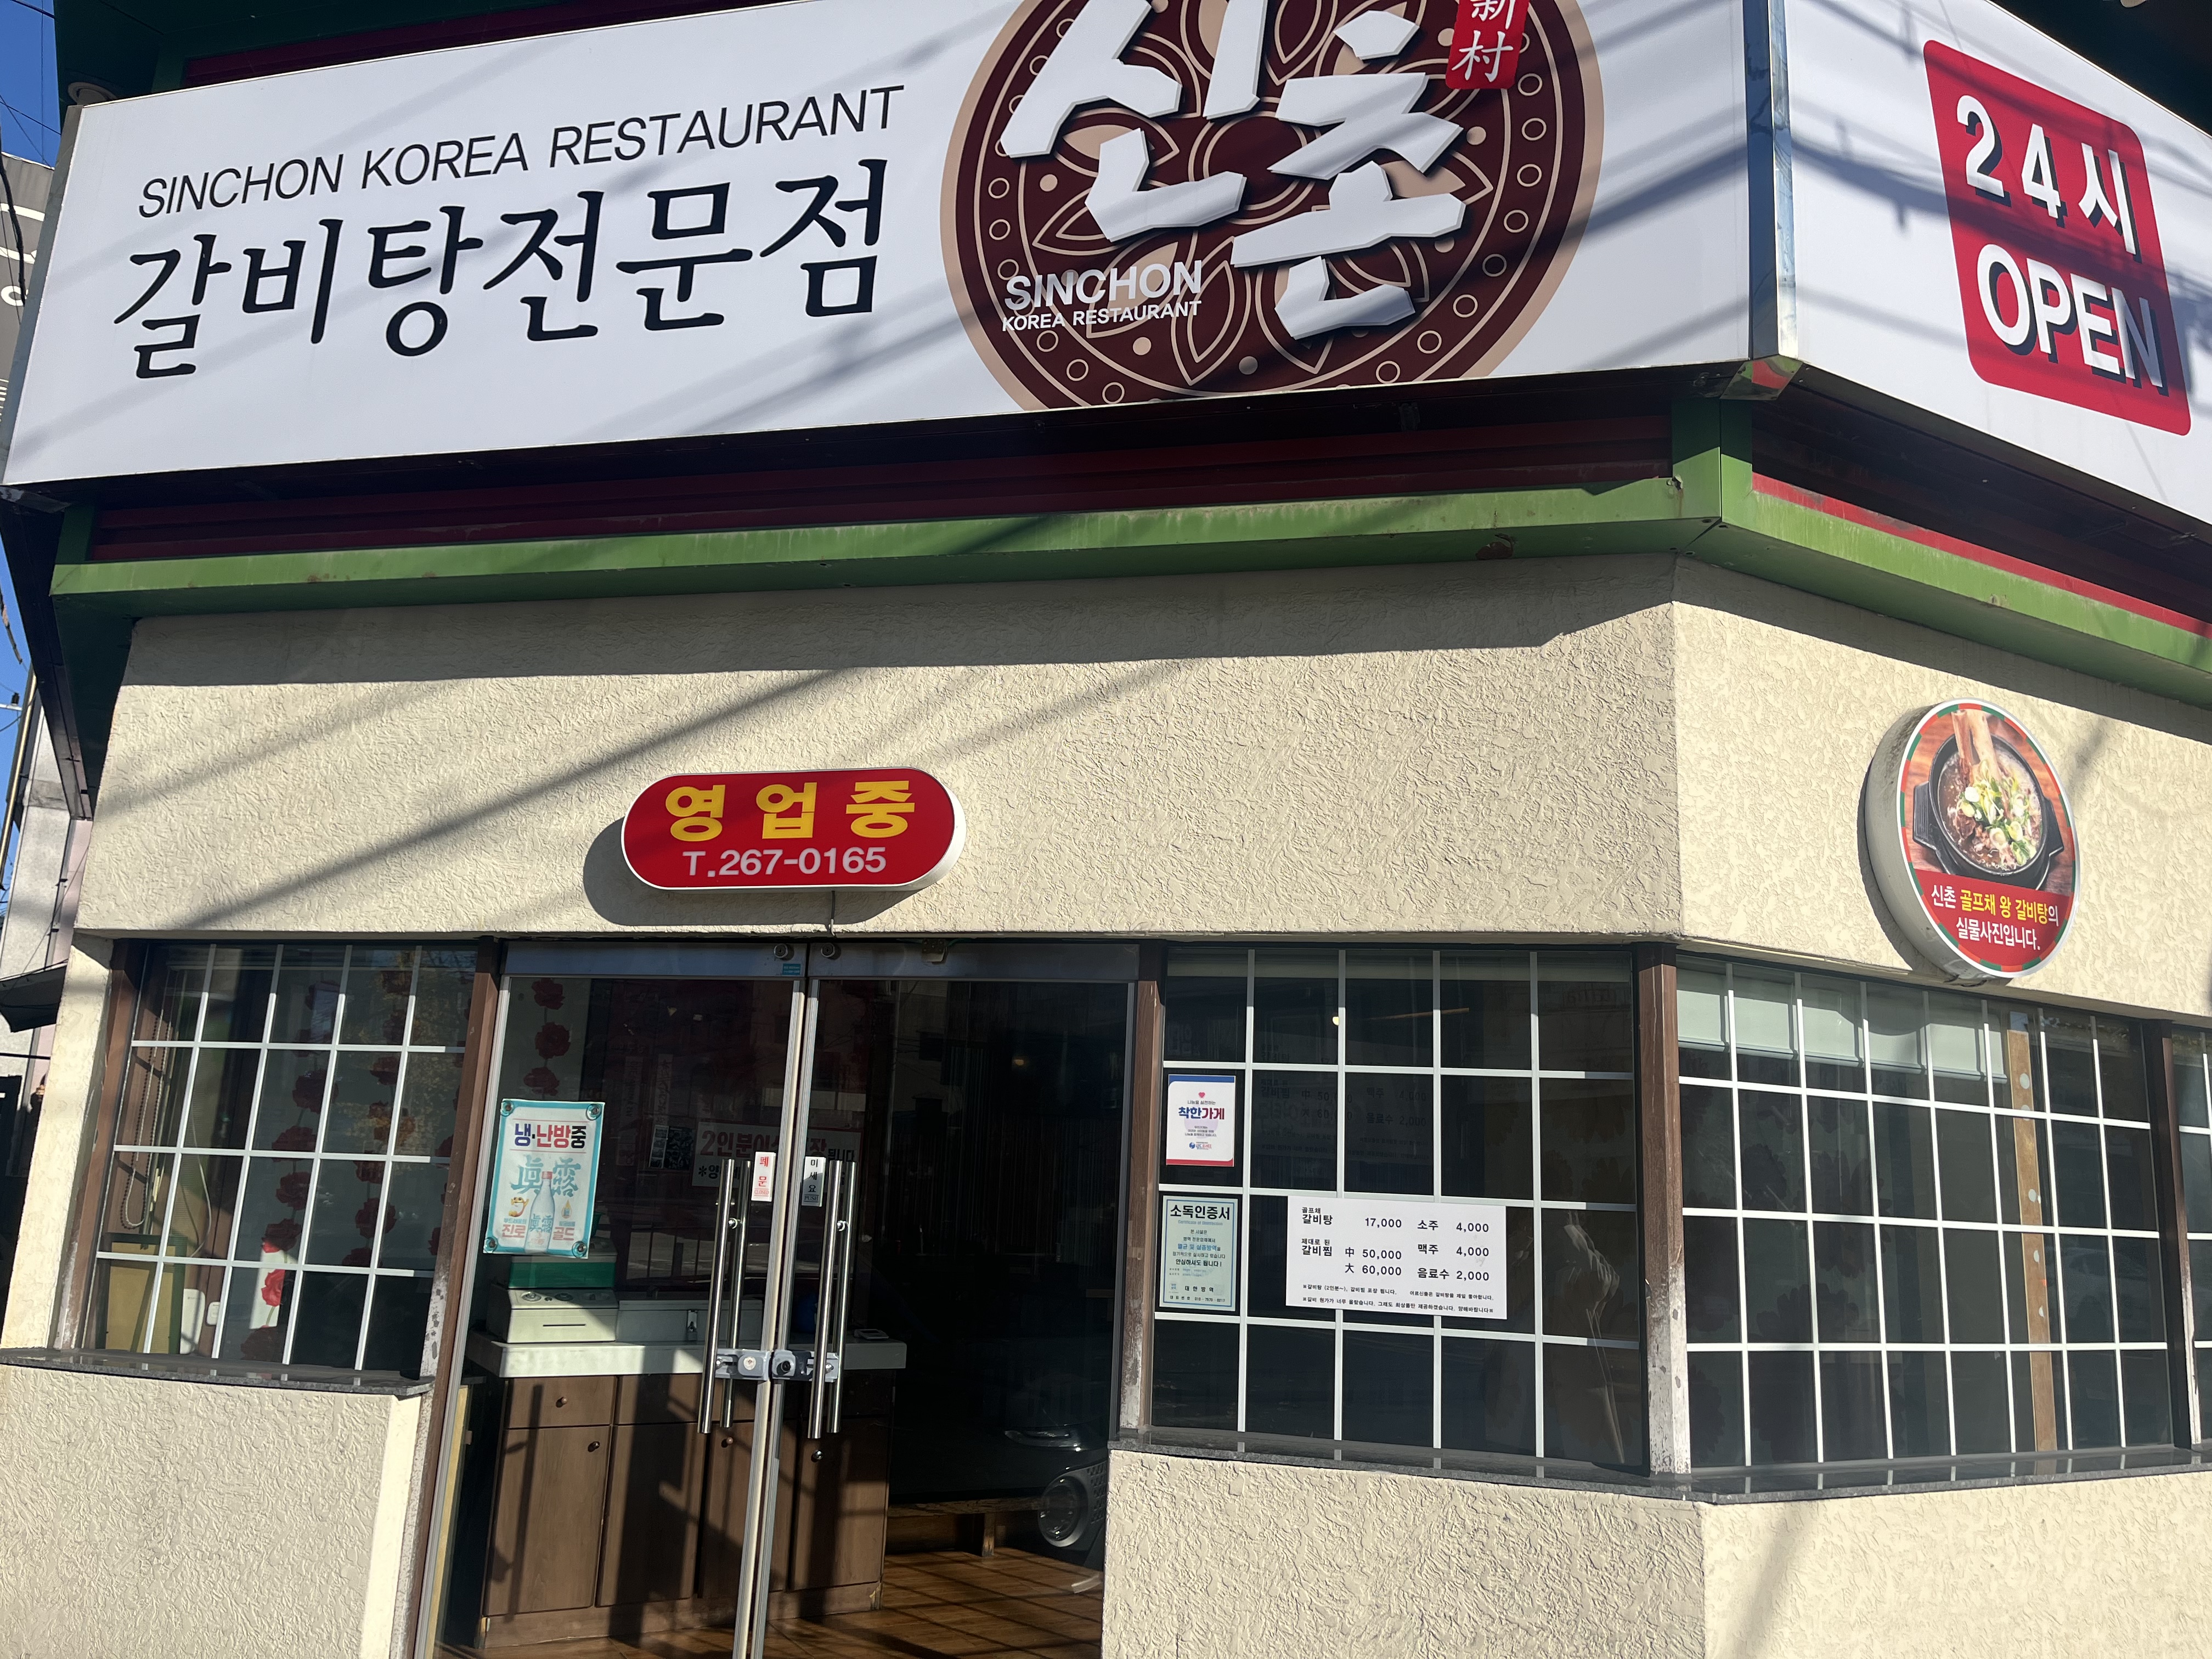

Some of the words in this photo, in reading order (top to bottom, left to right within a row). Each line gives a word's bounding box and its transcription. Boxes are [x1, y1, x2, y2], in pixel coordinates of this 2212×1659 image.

[138, 154, 342, 217] SINCHON
[362, 133, 527, 189] KOREA
[549, 86, 904, 166] RESTAURANT
[115, 159, 888, 377] 갈비탕전문점
[1005, 260, 1201, 311] SINCHON
[1002, 310, 1065, 331] KOREA
[1073, 301, 1201, 326] RESTAURANT
[1977, 244, 2166, 388] OPEN
[682, 847, 886, 877] T.267-0165
[1931, 884, 1956, 908] 신촌
[1960, 890, 1995, 916] 골프채
[2000, 896, 2012, 918] 왕
[2015, 899, 2059, 927] 갈비탕의
[1956, 917, 2041, 951] 실물사진입니다.
[1178, 1107, 1225, 1120] 착한가게
[808, 1159, 818, 1192] 미세요
[1170, 1205, 1230, 1220] 소독인증서
[1302, 1214, 1333, 1225] 갈비탕
[1365, 1217, 1402, 1229] 17,000
[1417, 1220, 1438, 1231] 소주
[1455, 1222, 1489, 1233] 4,000
[502, 1224, 525, 1238] 진로
[552, 1227, 575, 1240] 골드
[1301, 1245, 1333, 1257] 갈비찜
[1345, 1247, 1355, 1258] 中
[1362, 1249, 1402, 1260] 50,000
[1417, 1243, 1439, 1255] 맥주
[1455, 1246, 1489, 1257] 4,000
[1345, 1263, 1355, 1274] 大
[1362, 1265, 1402, 1276] 60,000
[1417, 1267, 1450, 1279] 음료수
[1456, 1271, 1489, 1282] 2,000
